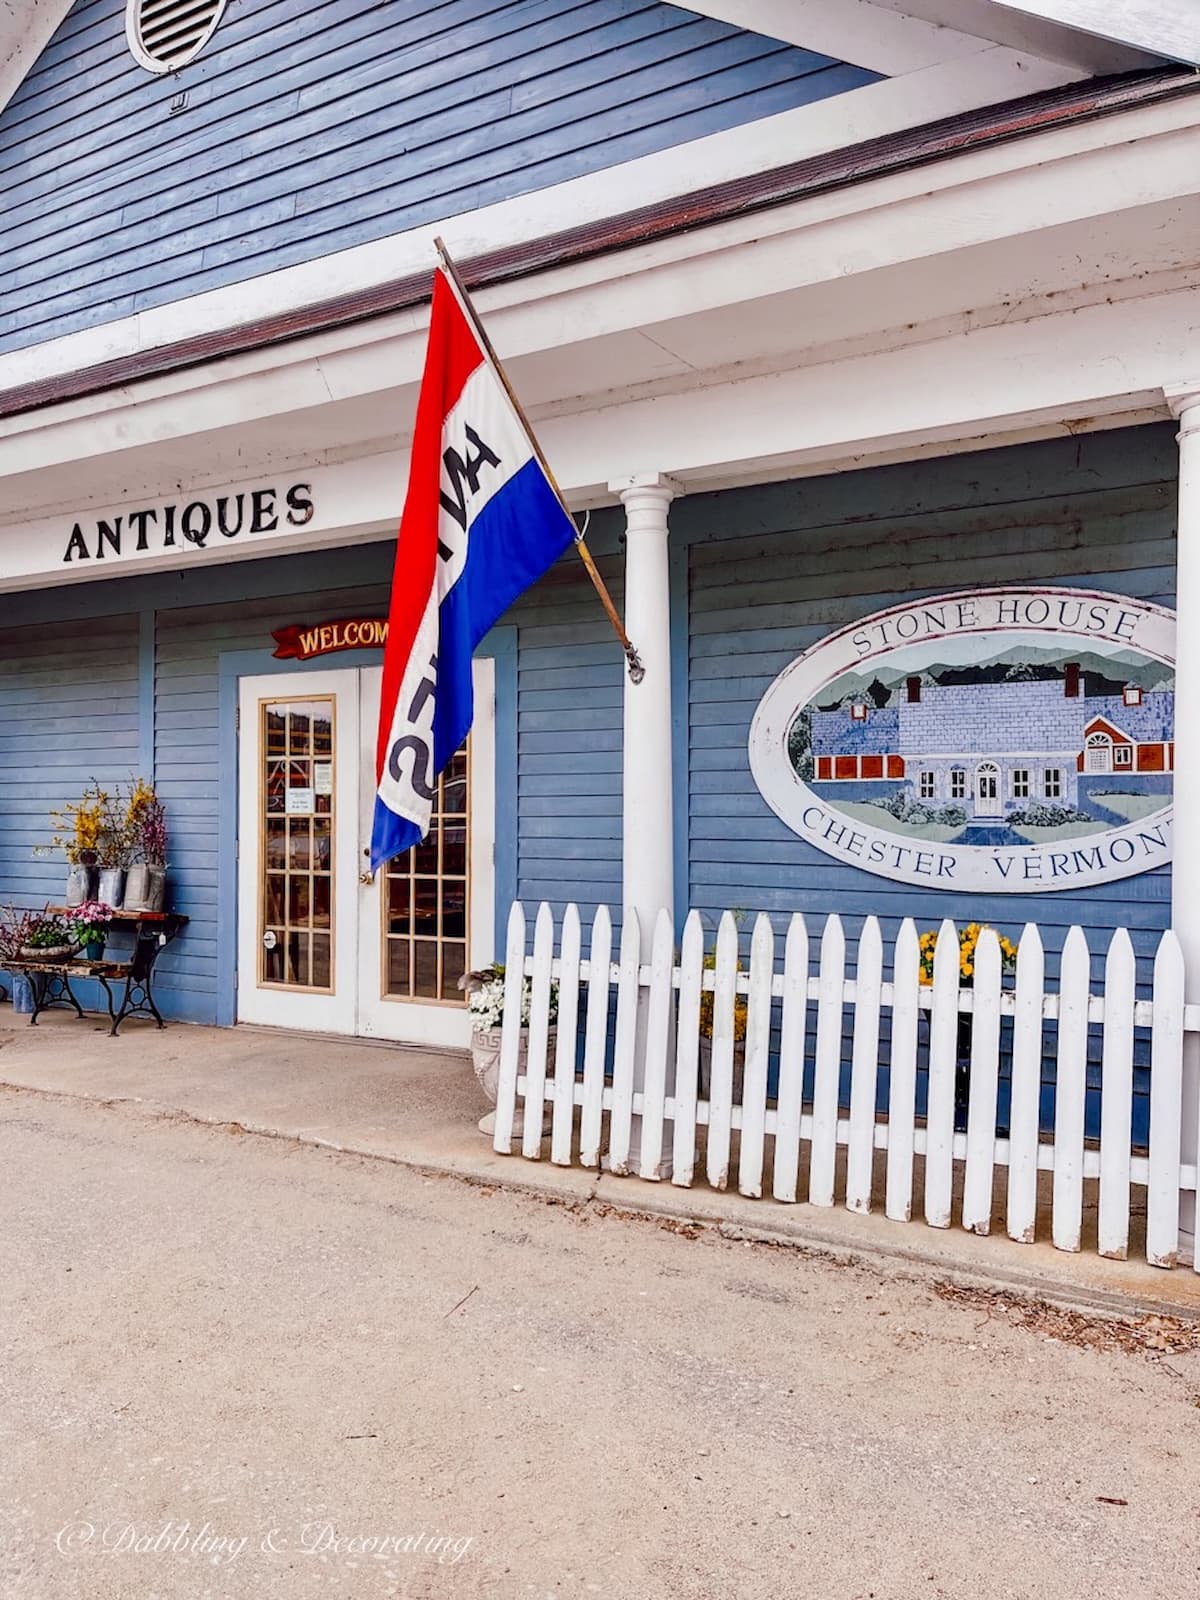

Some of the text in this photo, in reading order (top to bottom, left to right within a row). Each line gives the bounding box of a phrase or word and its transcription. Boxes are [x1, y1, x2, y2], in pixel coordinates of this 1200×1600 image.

[63, 484, 313, 562] ANTIQUES
[298, 621, 390, 655] WELCOM
[852, 599, 1142, 655] STONE HOUSE
[802, 807, 957, 879] CHESTER
